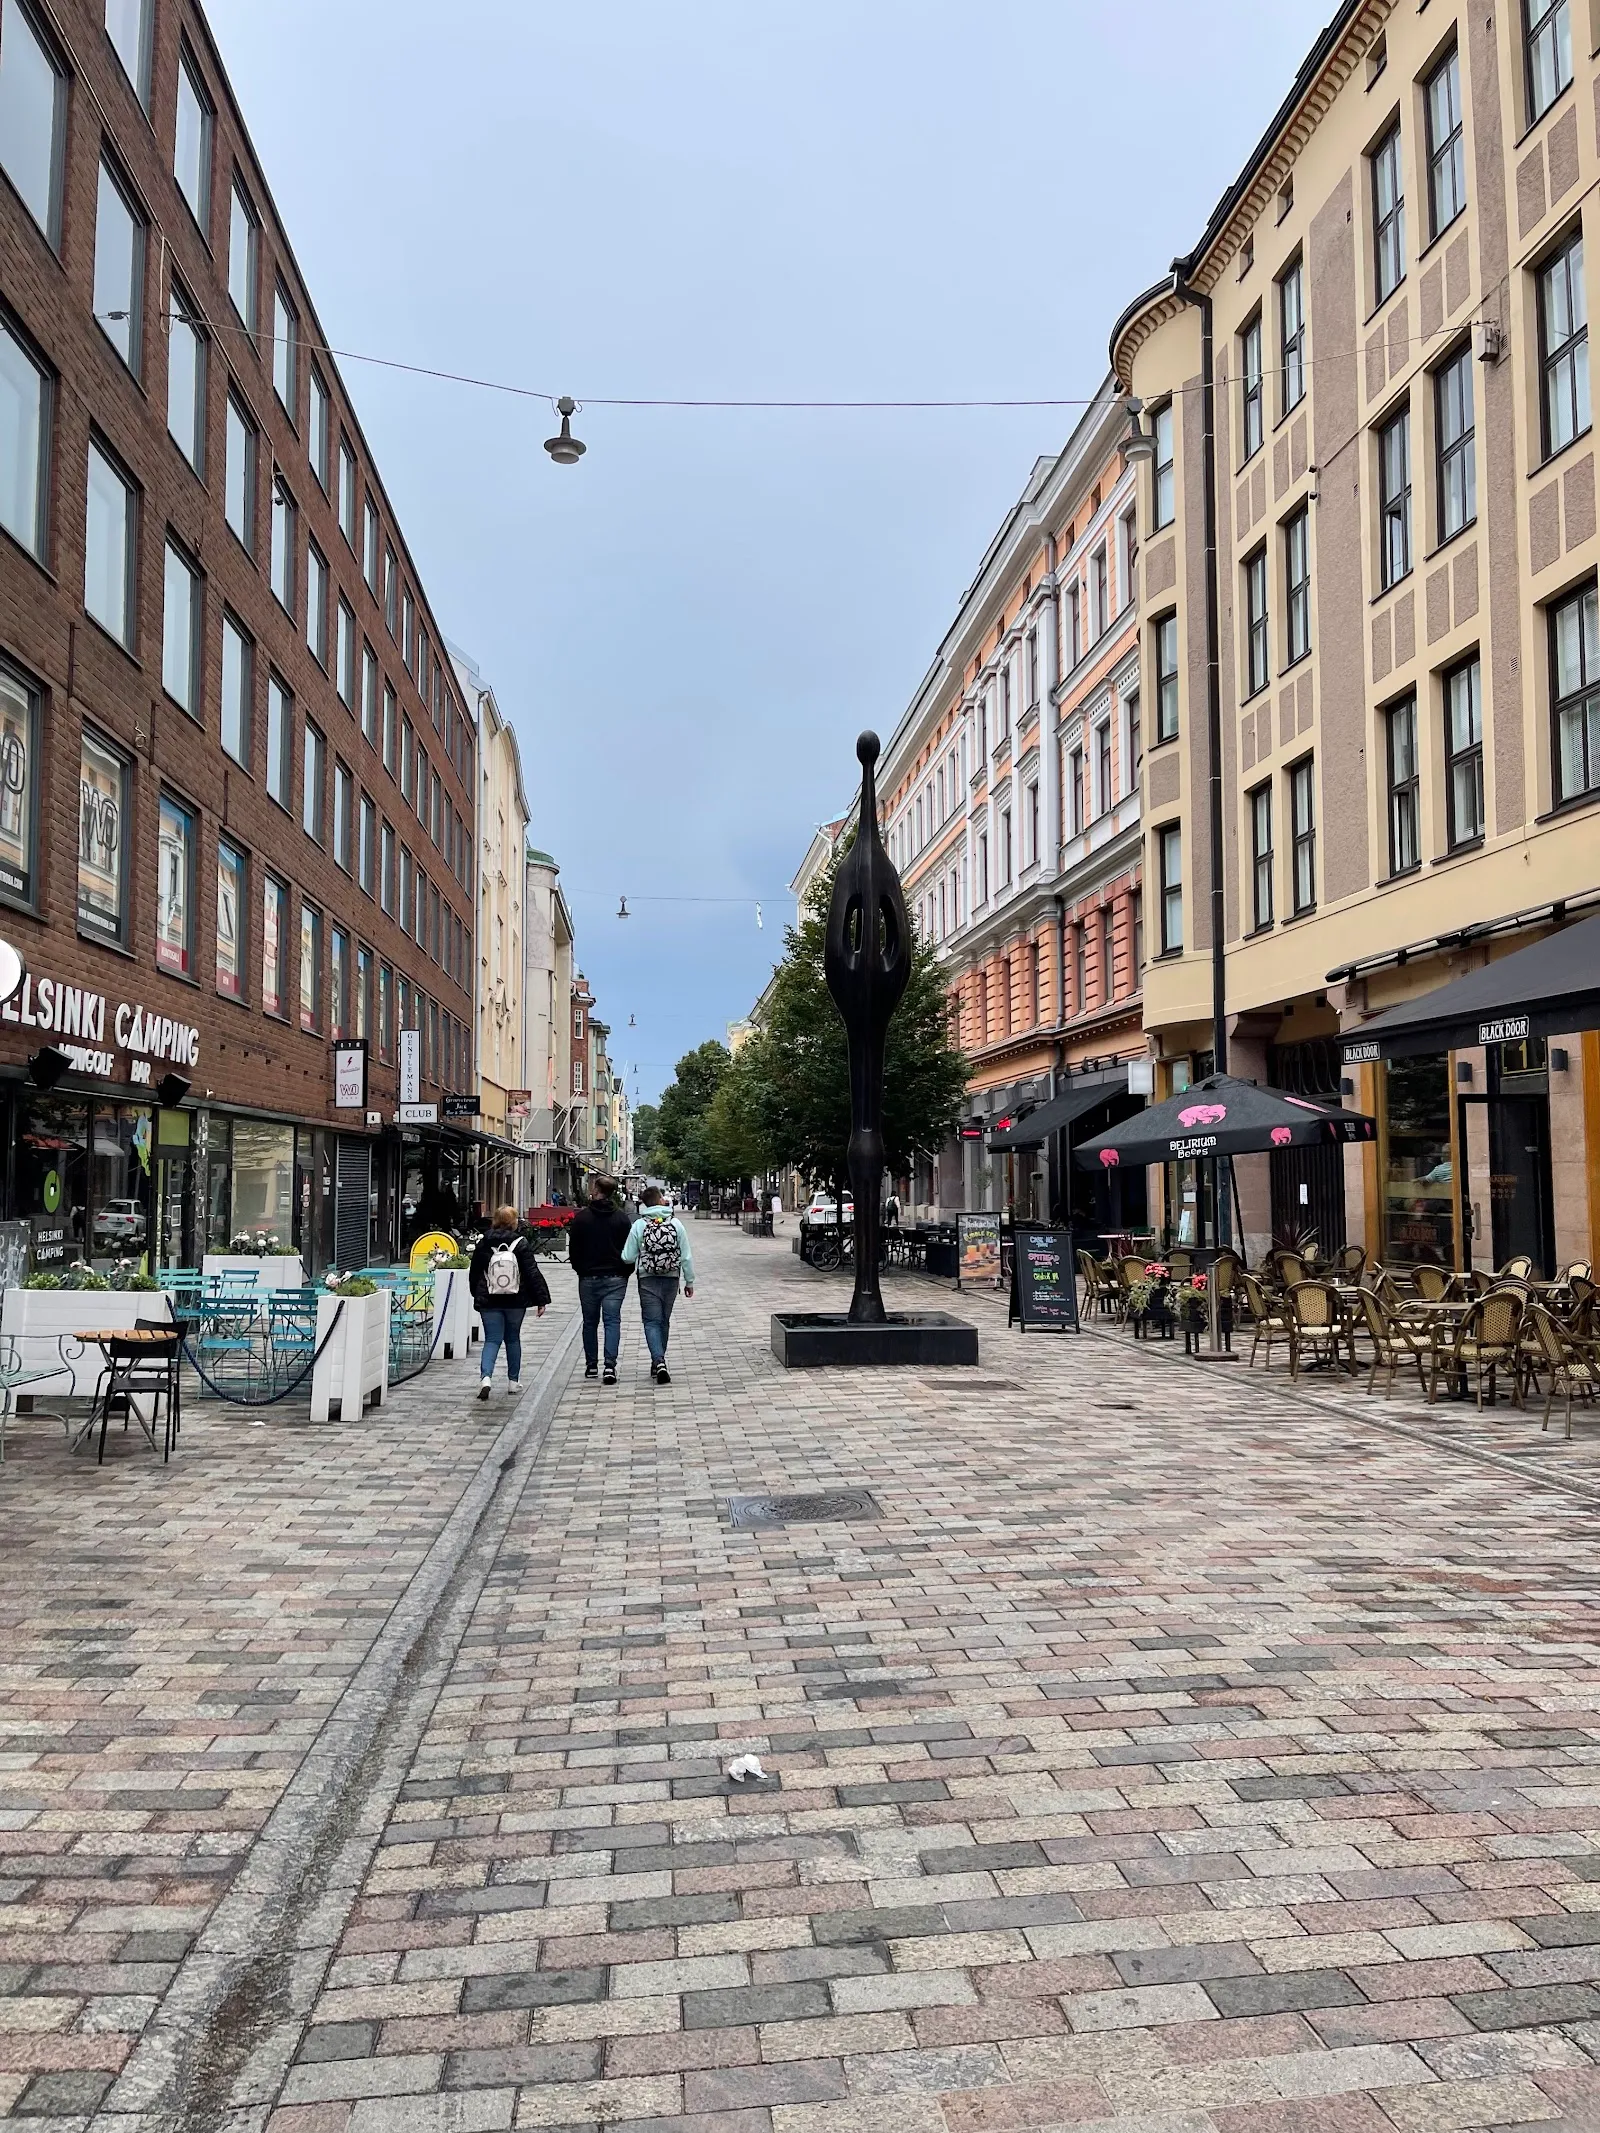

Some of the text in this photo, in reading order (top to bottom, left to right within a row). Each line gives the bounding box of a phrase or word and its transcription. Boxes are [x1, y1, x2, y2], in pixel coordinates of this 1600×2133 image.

[115, 1002, 200, 1067] CAMPING
[1481, 1020, 1527, 1041] BLACK DOOR
[1345, 1044, 1379, 1061] BLACK DOOR
[130, 1059, 151, 1085] BAR
[406, 1032, 414, 1100] GENTLEMANS
[405, 1109, 432, 1118] CLUB
[1169, 1136, 1217, 1151] DELIRIUM
[1177, 1147, 1209, 1159] Beers
[37, 1230, 63, 1242] HELSINKI
[37, 1246, 64, 1260] CAMPING
